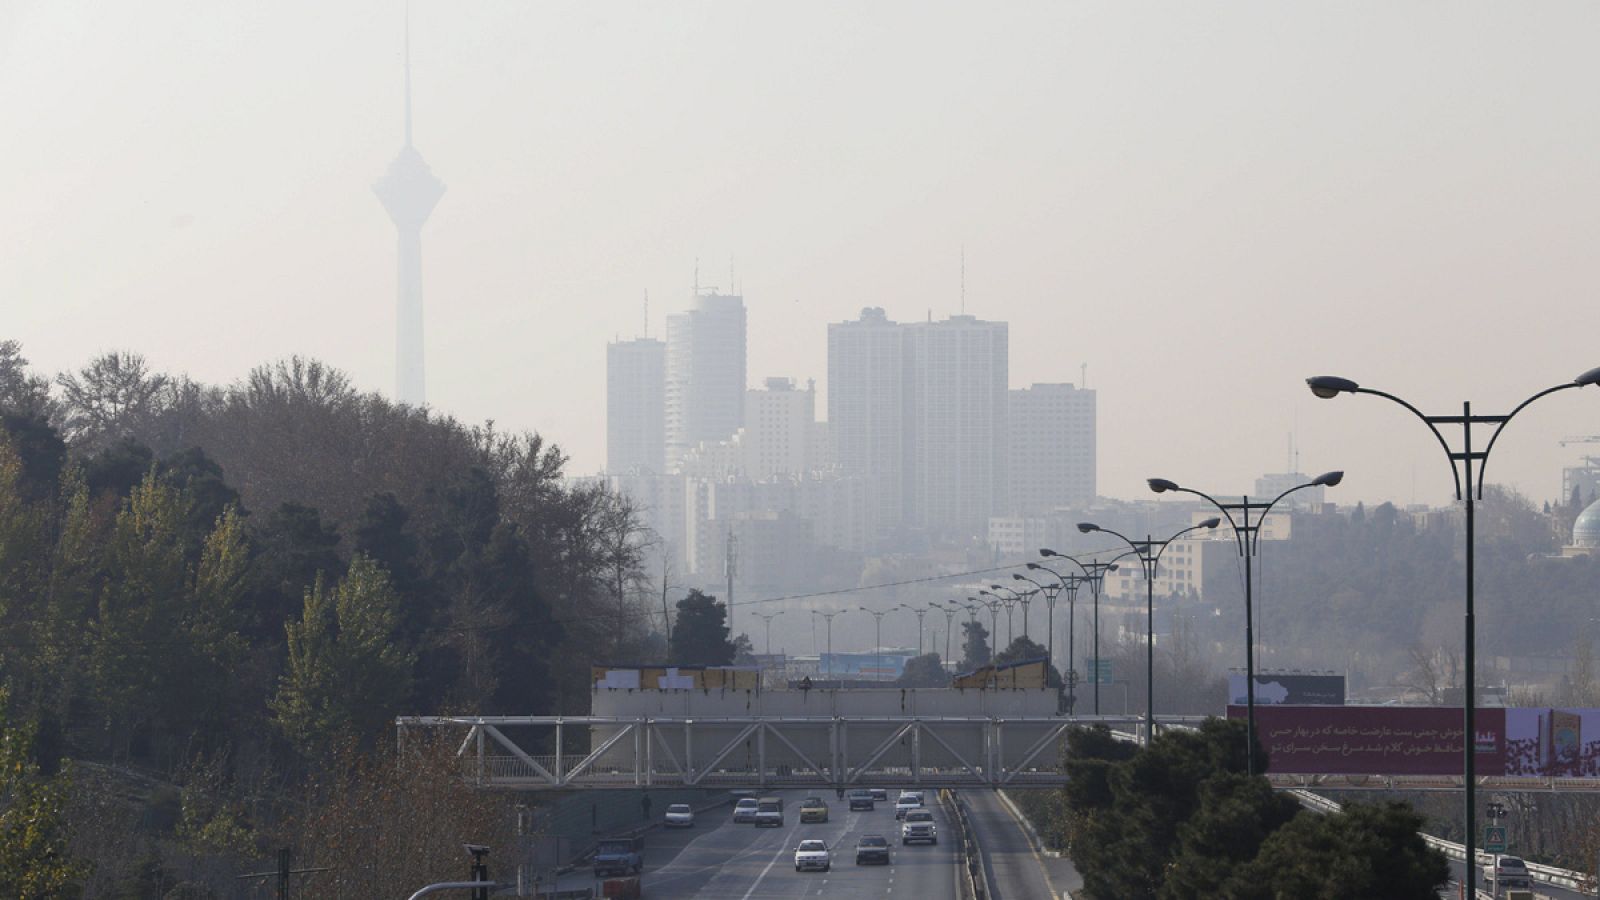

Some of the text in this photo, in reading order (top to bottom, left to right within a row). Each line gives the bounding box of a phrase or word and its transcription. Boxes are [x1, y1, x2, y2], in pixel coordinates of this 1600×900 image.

[1294, 727, 1308, 738] بهار
[1309, 728, 1320, 738] در
[1322, 725, 1333, 735] که
[1440, 727, 1464, 740] خوش
[1342, 741, 1364, 757] مرغ
[1365, 743, 1382, 752] شد
[1384, 742, 1403, 757] کلام
